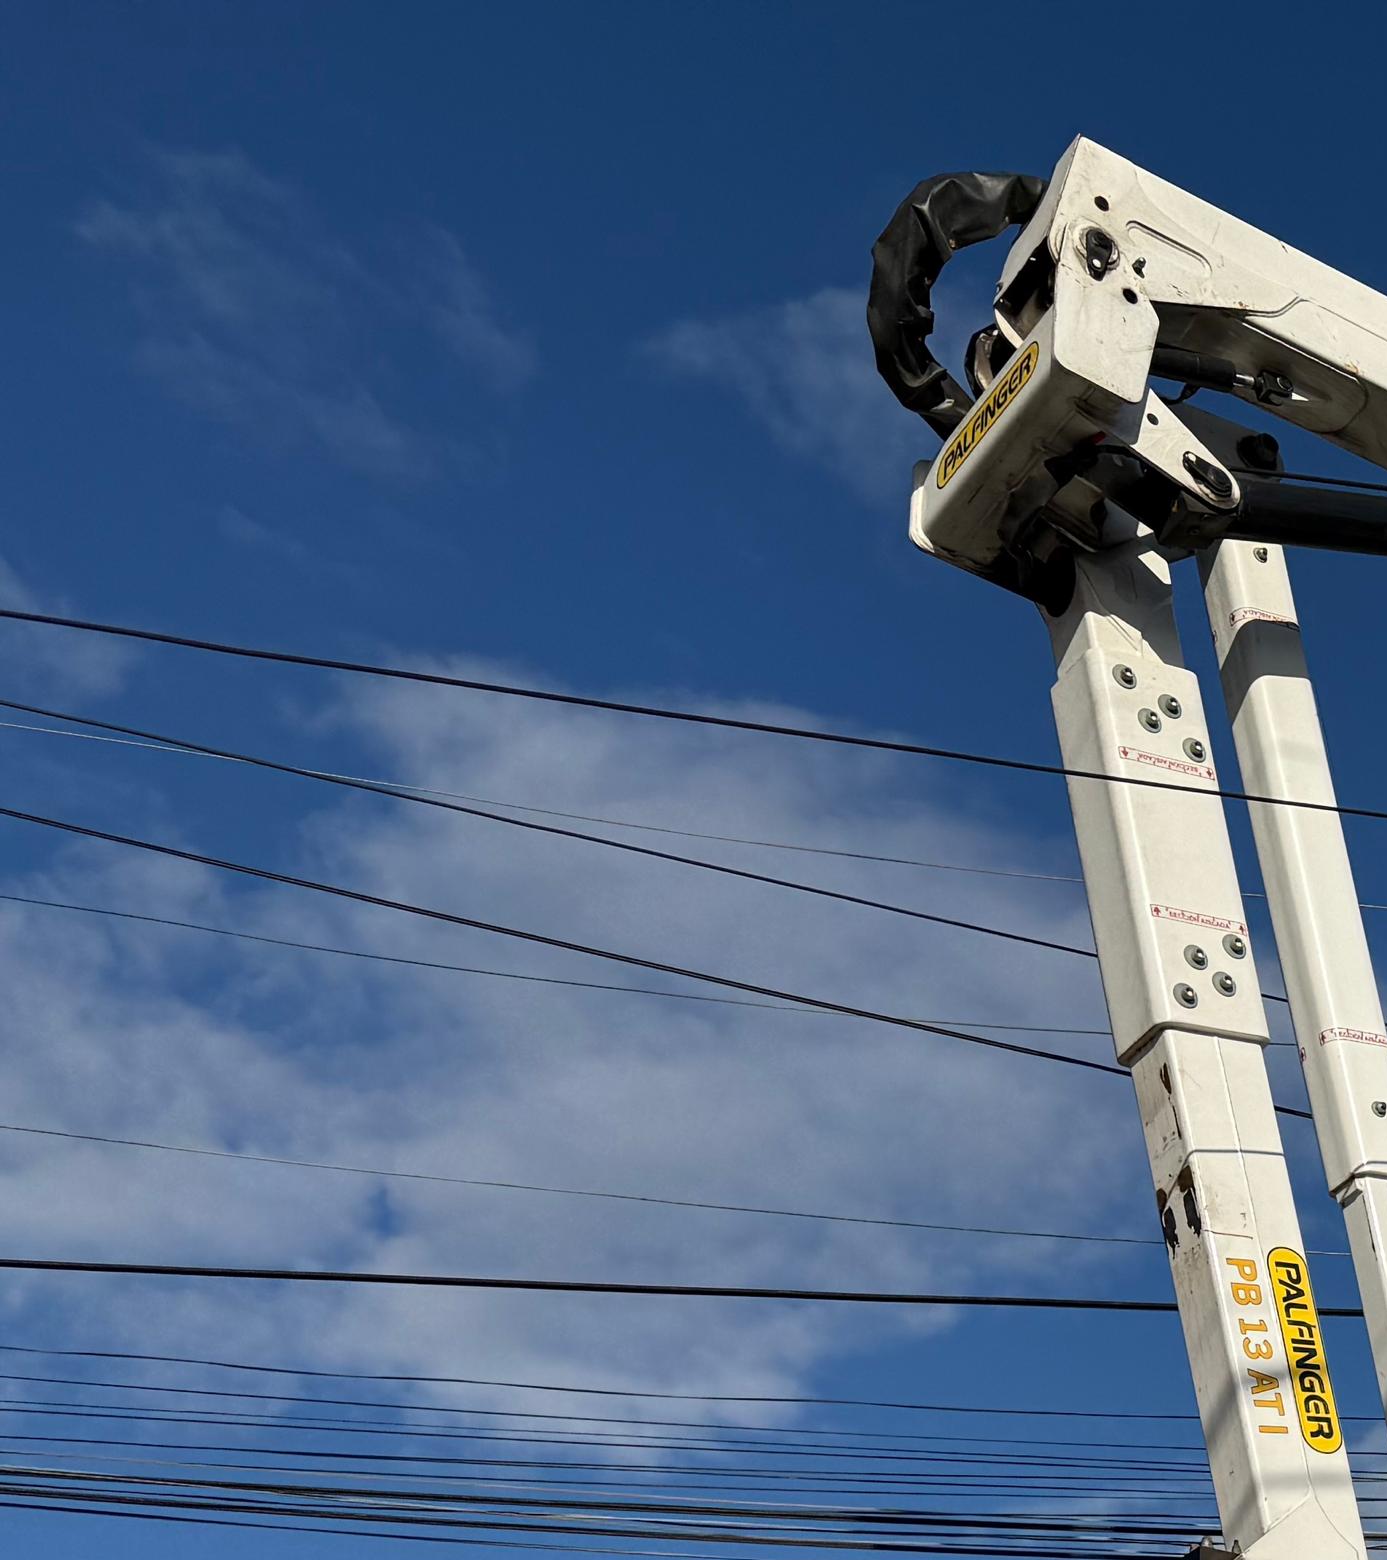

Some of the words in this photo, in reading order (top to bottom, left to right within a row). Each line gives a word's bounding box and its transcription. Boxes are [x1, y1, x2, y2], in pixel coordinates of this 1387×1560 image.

[943, 353, 1032, 480] PALFINGER
[1225, 1257, 1263, 1306] PB
[1238, 1319, 1273, 1360] 13
[1274, 1261, 1334, 1439] PALFINGER
[1247, 1369, 1287, 1416] AT
